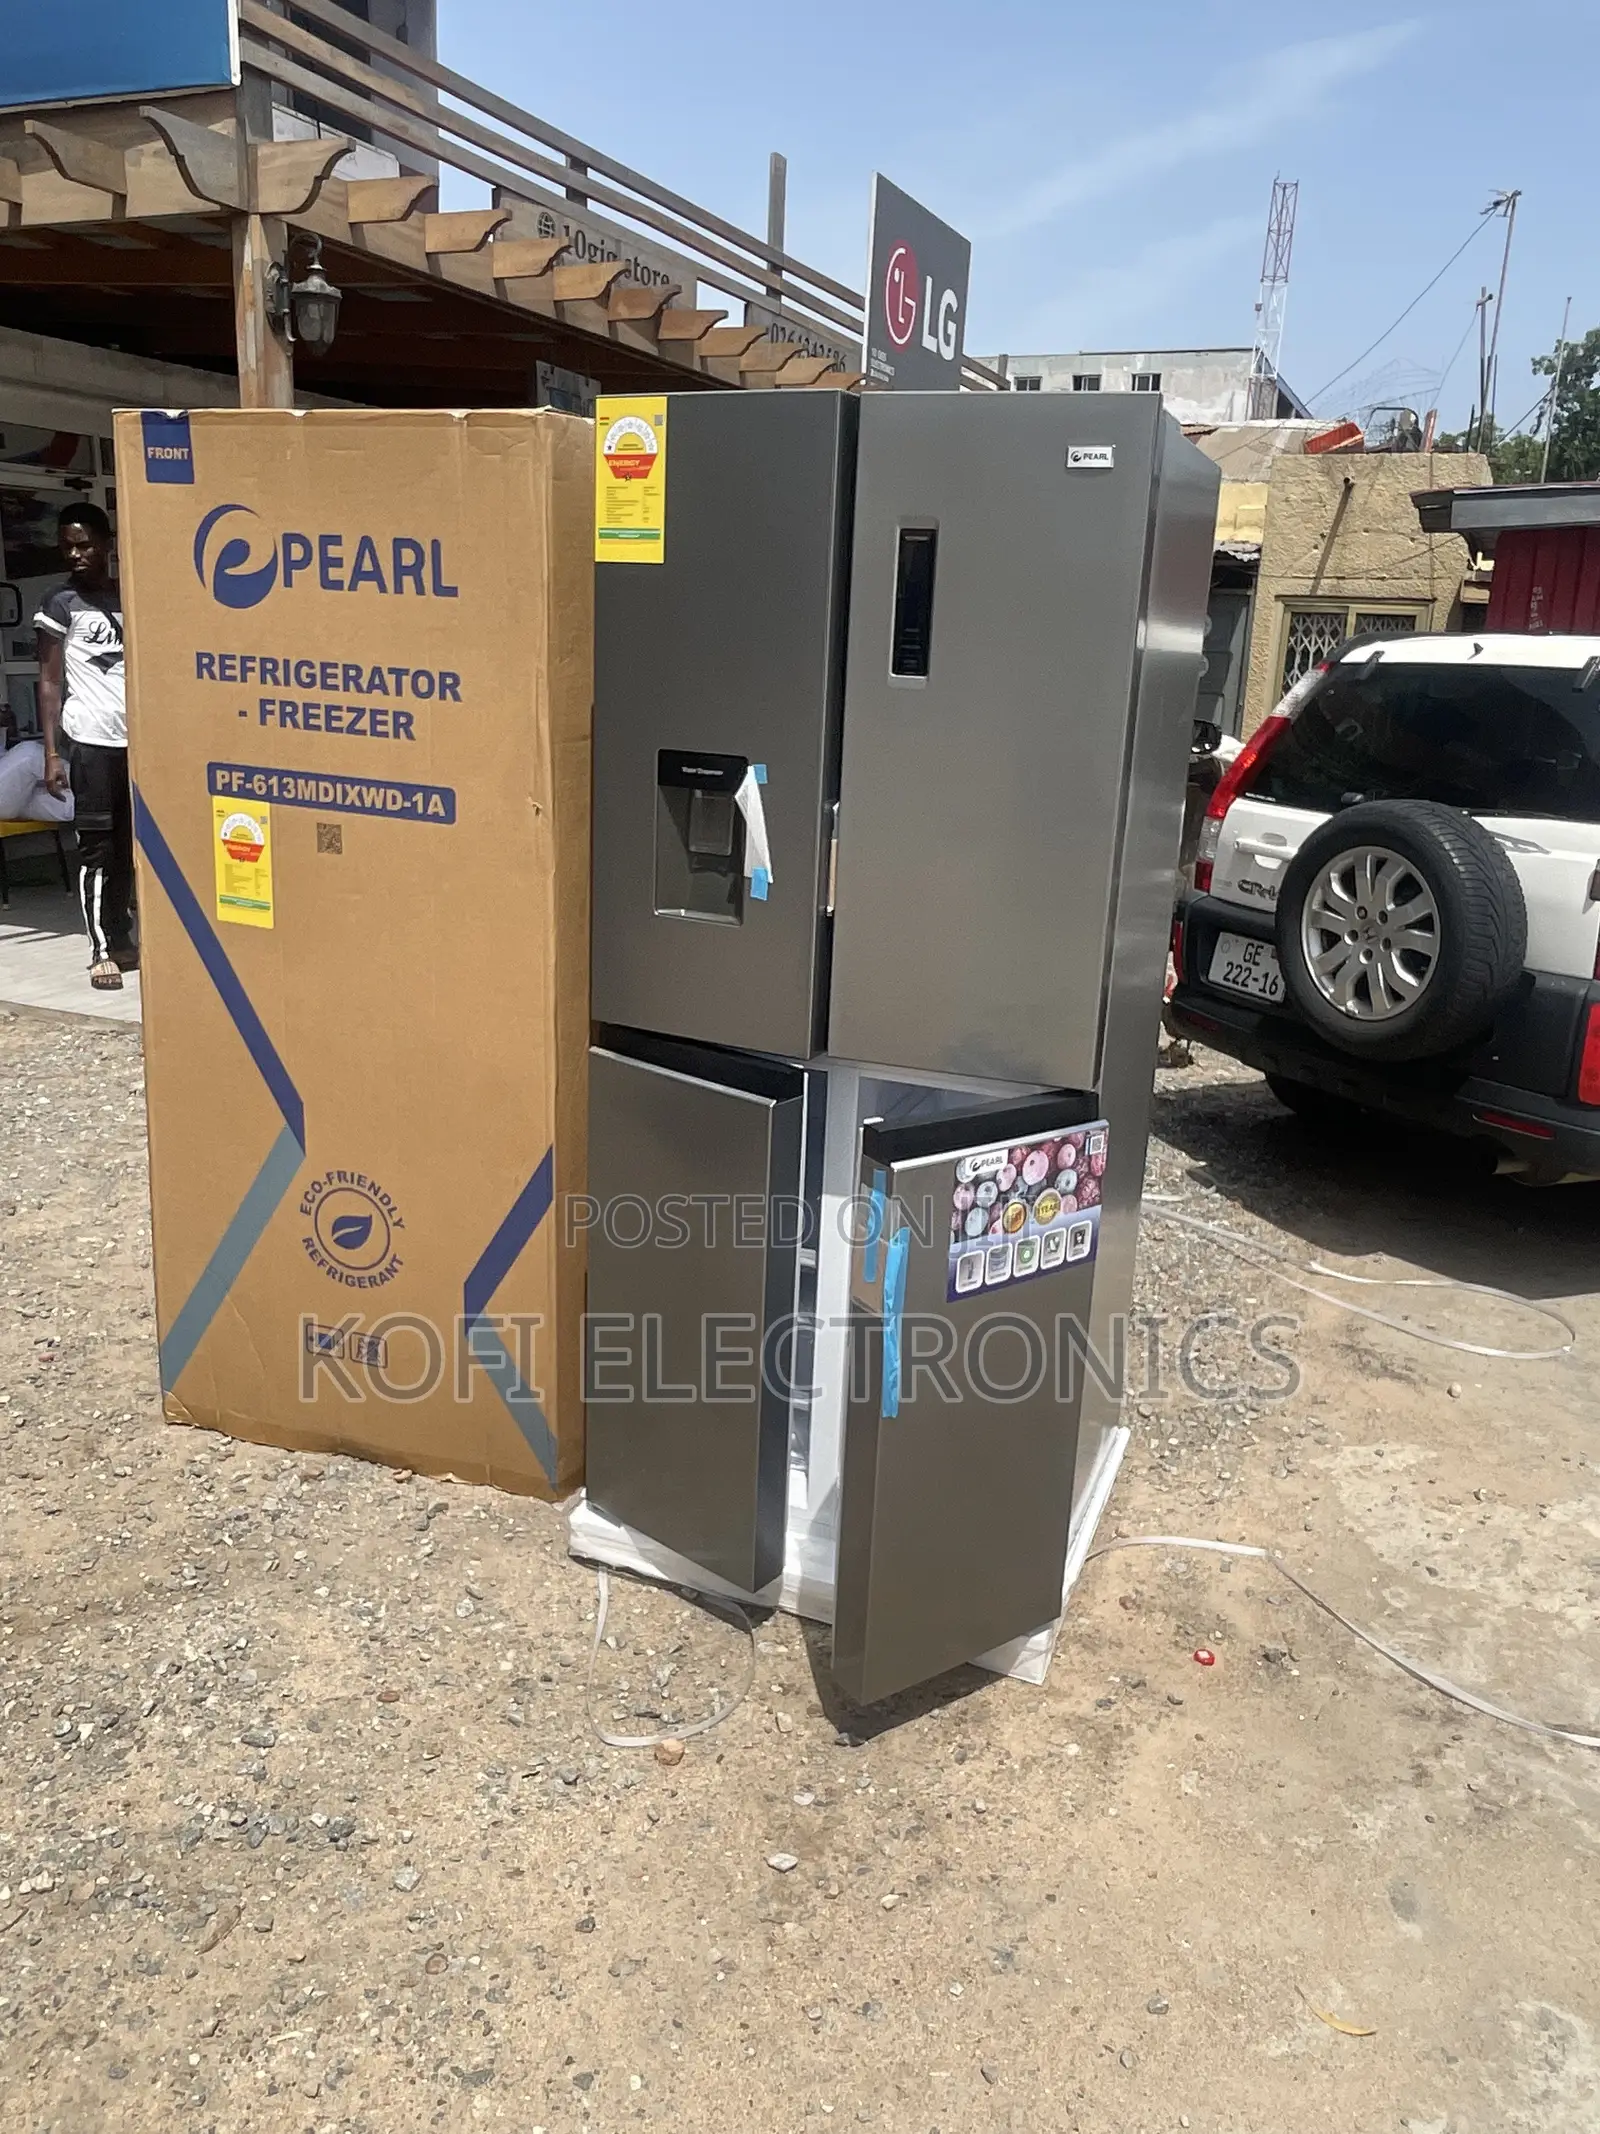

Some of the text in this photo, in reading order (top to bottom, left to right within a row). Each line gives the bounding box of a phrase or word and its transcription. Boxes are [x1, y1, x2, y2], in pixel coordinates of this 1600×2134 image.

[921, 275, 959, 361] LG
[147, 446, 190, 461] FRONT
[1083, 452, 1109, 461] PEARL
[282, 532, 459, 598] PEARL
[195, 651, 463, 702] REFRIGERATOR
[258, 698, 416, 741] FREEZER
[214, 769, 446, 817] PF-613MDIXWD-1A
[1222, 961, 1279, 996] 222-16
[1243, 942, 1265, 967] GE
[299, 1169, 406, 1230] ECO-FRIENDLY
[301, 1236, 404, 1289] REFRIGERANT
